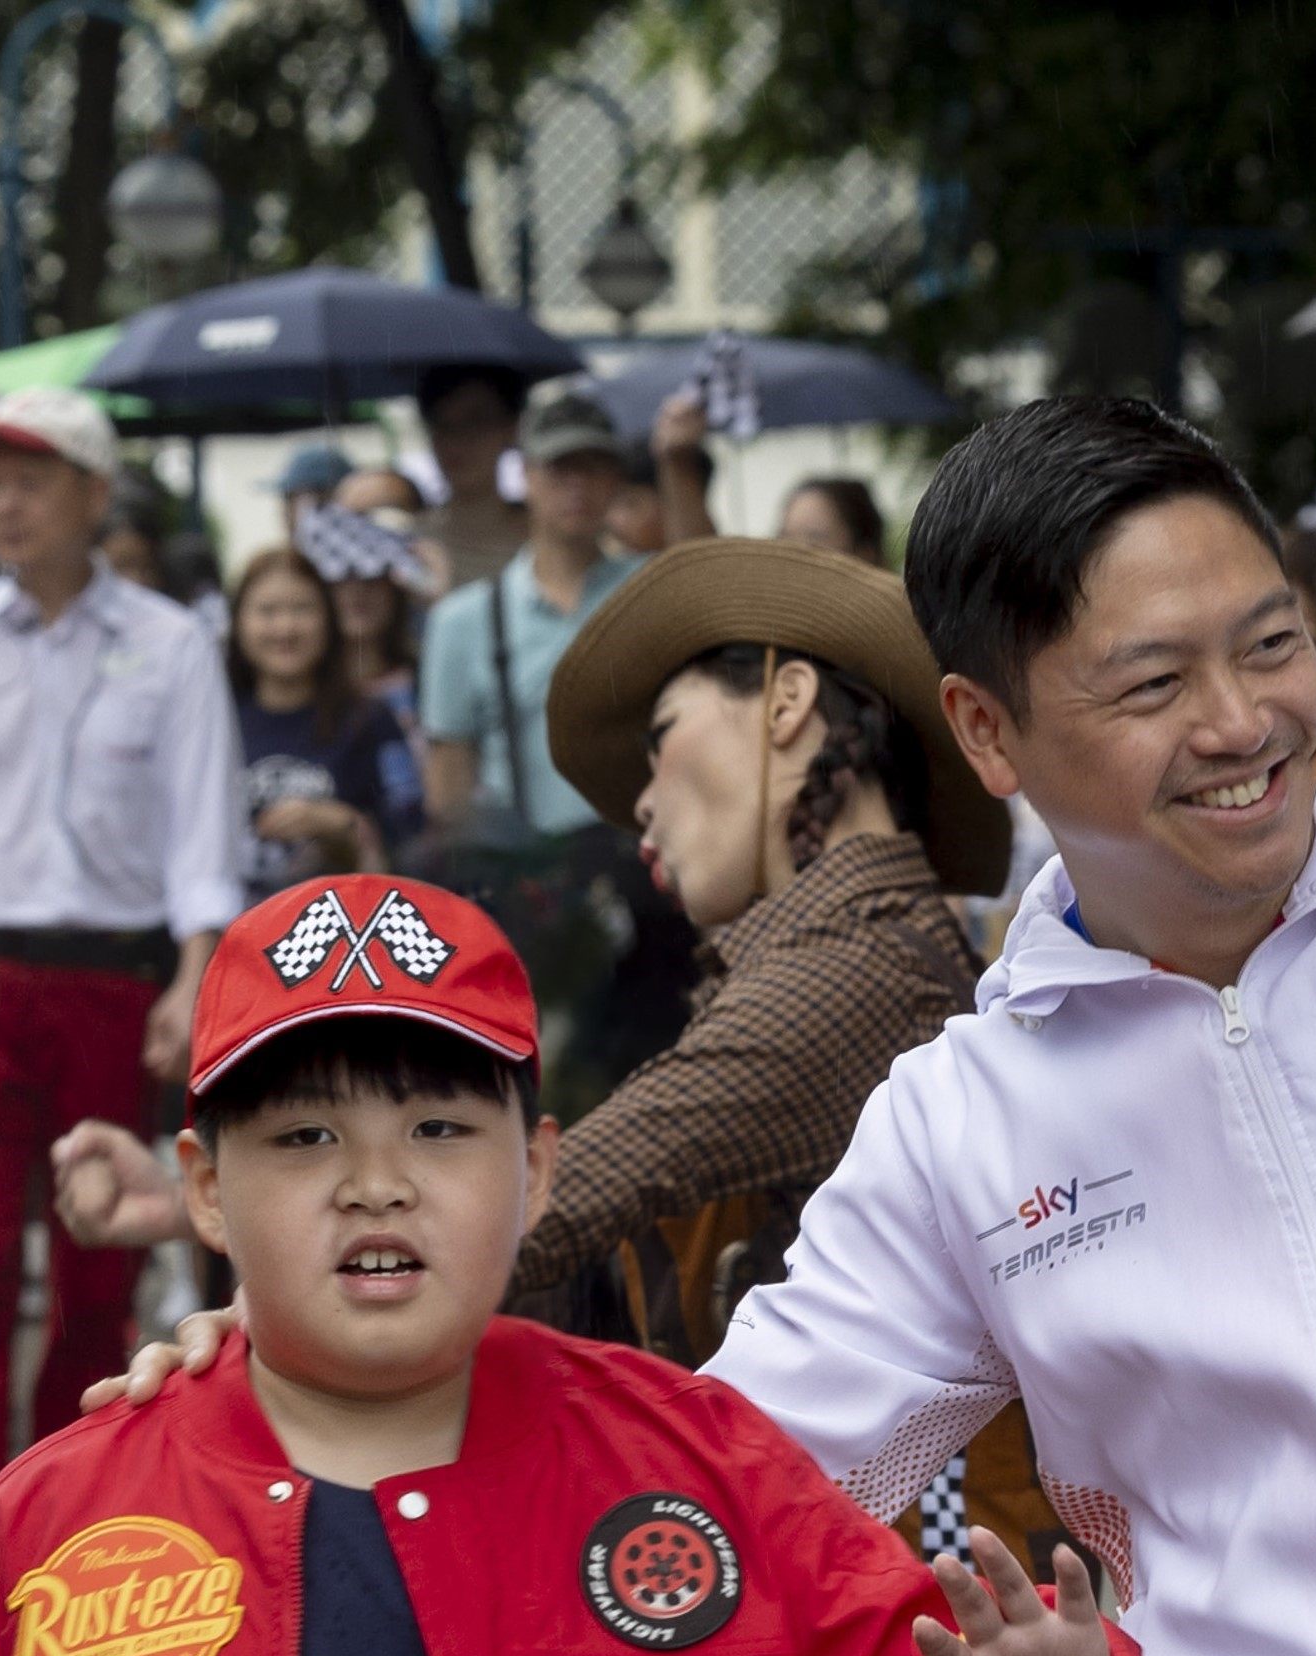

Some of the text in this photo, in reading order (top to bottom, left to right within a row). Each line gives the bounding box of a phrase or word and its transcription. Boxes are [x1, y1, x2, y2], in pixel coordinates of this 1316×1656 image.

[989, 1202, 1146, 1286] TEMPESTA
[1018, 1177, 1078, 1230] sky
[587, 1543, 677, 1642] LIGHTYEAR
[652, 1499, 739, 1598] LIGHTYEAR
